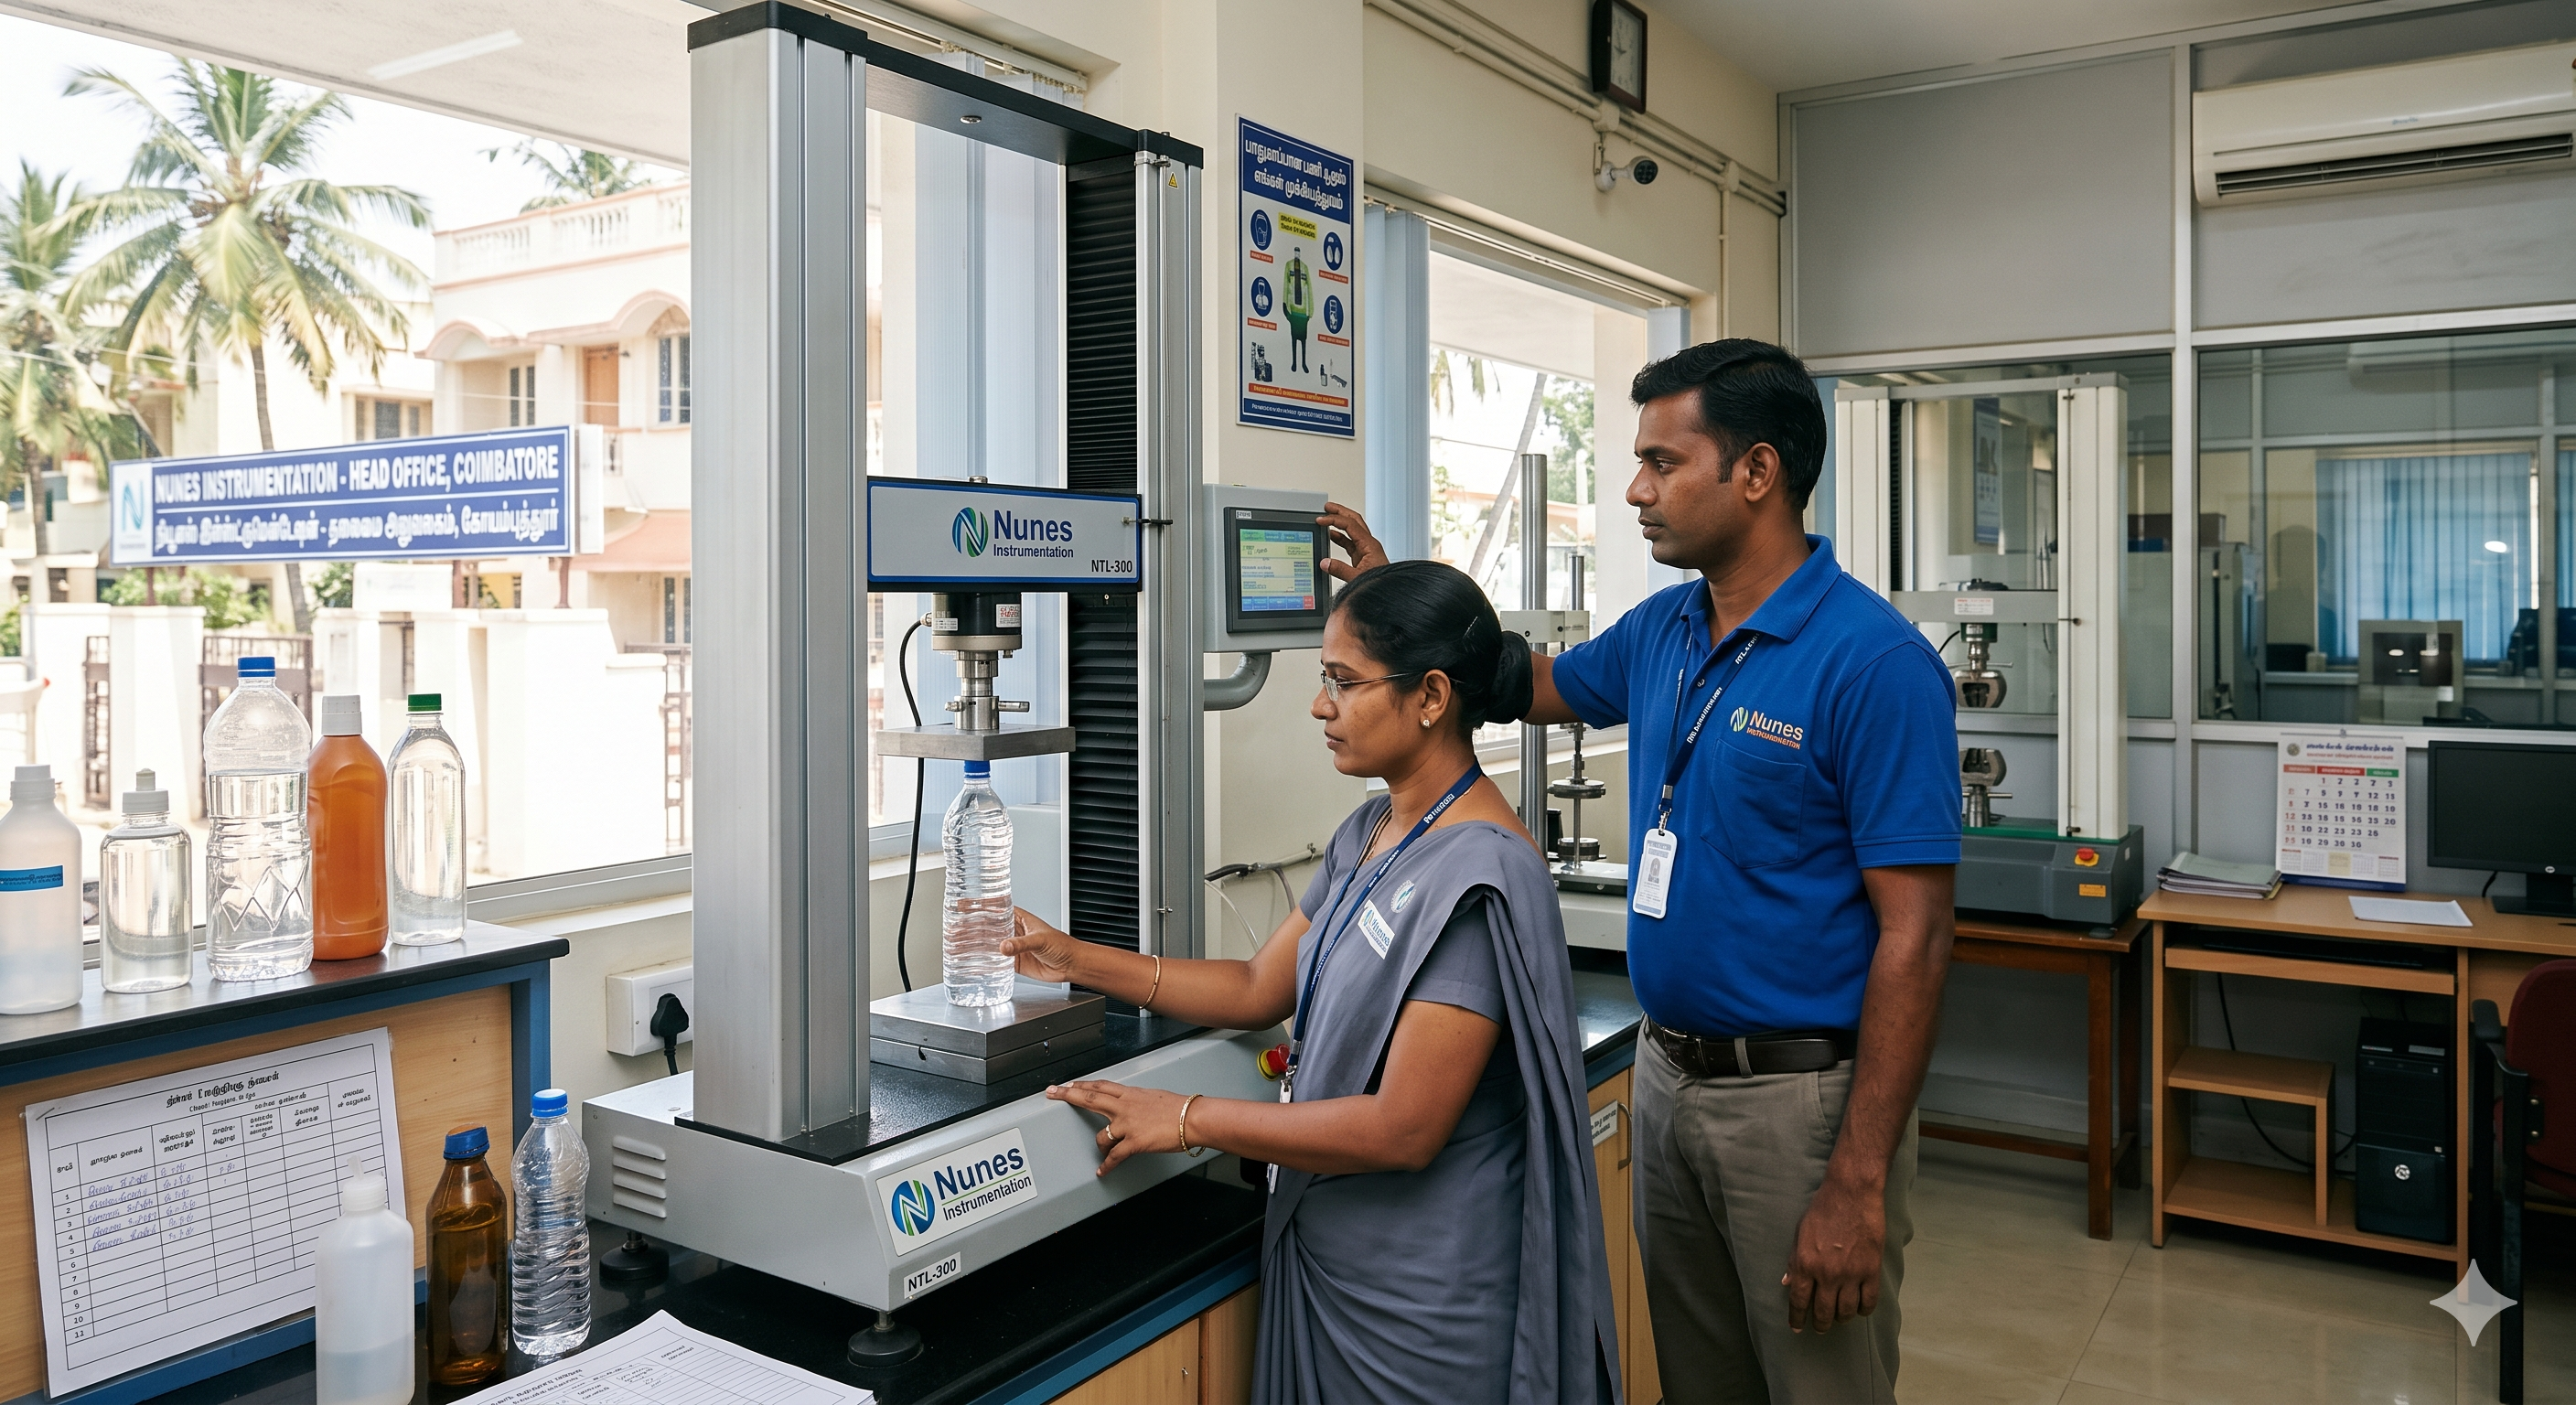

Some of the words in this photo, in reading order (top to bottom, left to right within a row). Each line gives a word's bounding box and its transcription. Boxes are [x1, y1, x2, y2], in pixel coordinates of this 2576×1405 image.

[155, 472, 201, 503] NUNES
[202, 461, 338, 501] INSTRUMENTATION
[349, 458, 390, 491] HEAD
[392, 454, 451, 492] OFFICE,
[453, 445, 559, 485] COIMBATORE
[993, 509, 1073, 542] Nunes
[993, 543, 1074, 558] Instrumentation
[1090, 559, 1133, 574] NTL-300
[1749, 710, 1804, 741] Nunes
[933, 1147, 1025, 1200] Nunes
[942, 1176, 1032, 1221] Instrumentation
[907, 1258, 957, 1292] NTL-300
